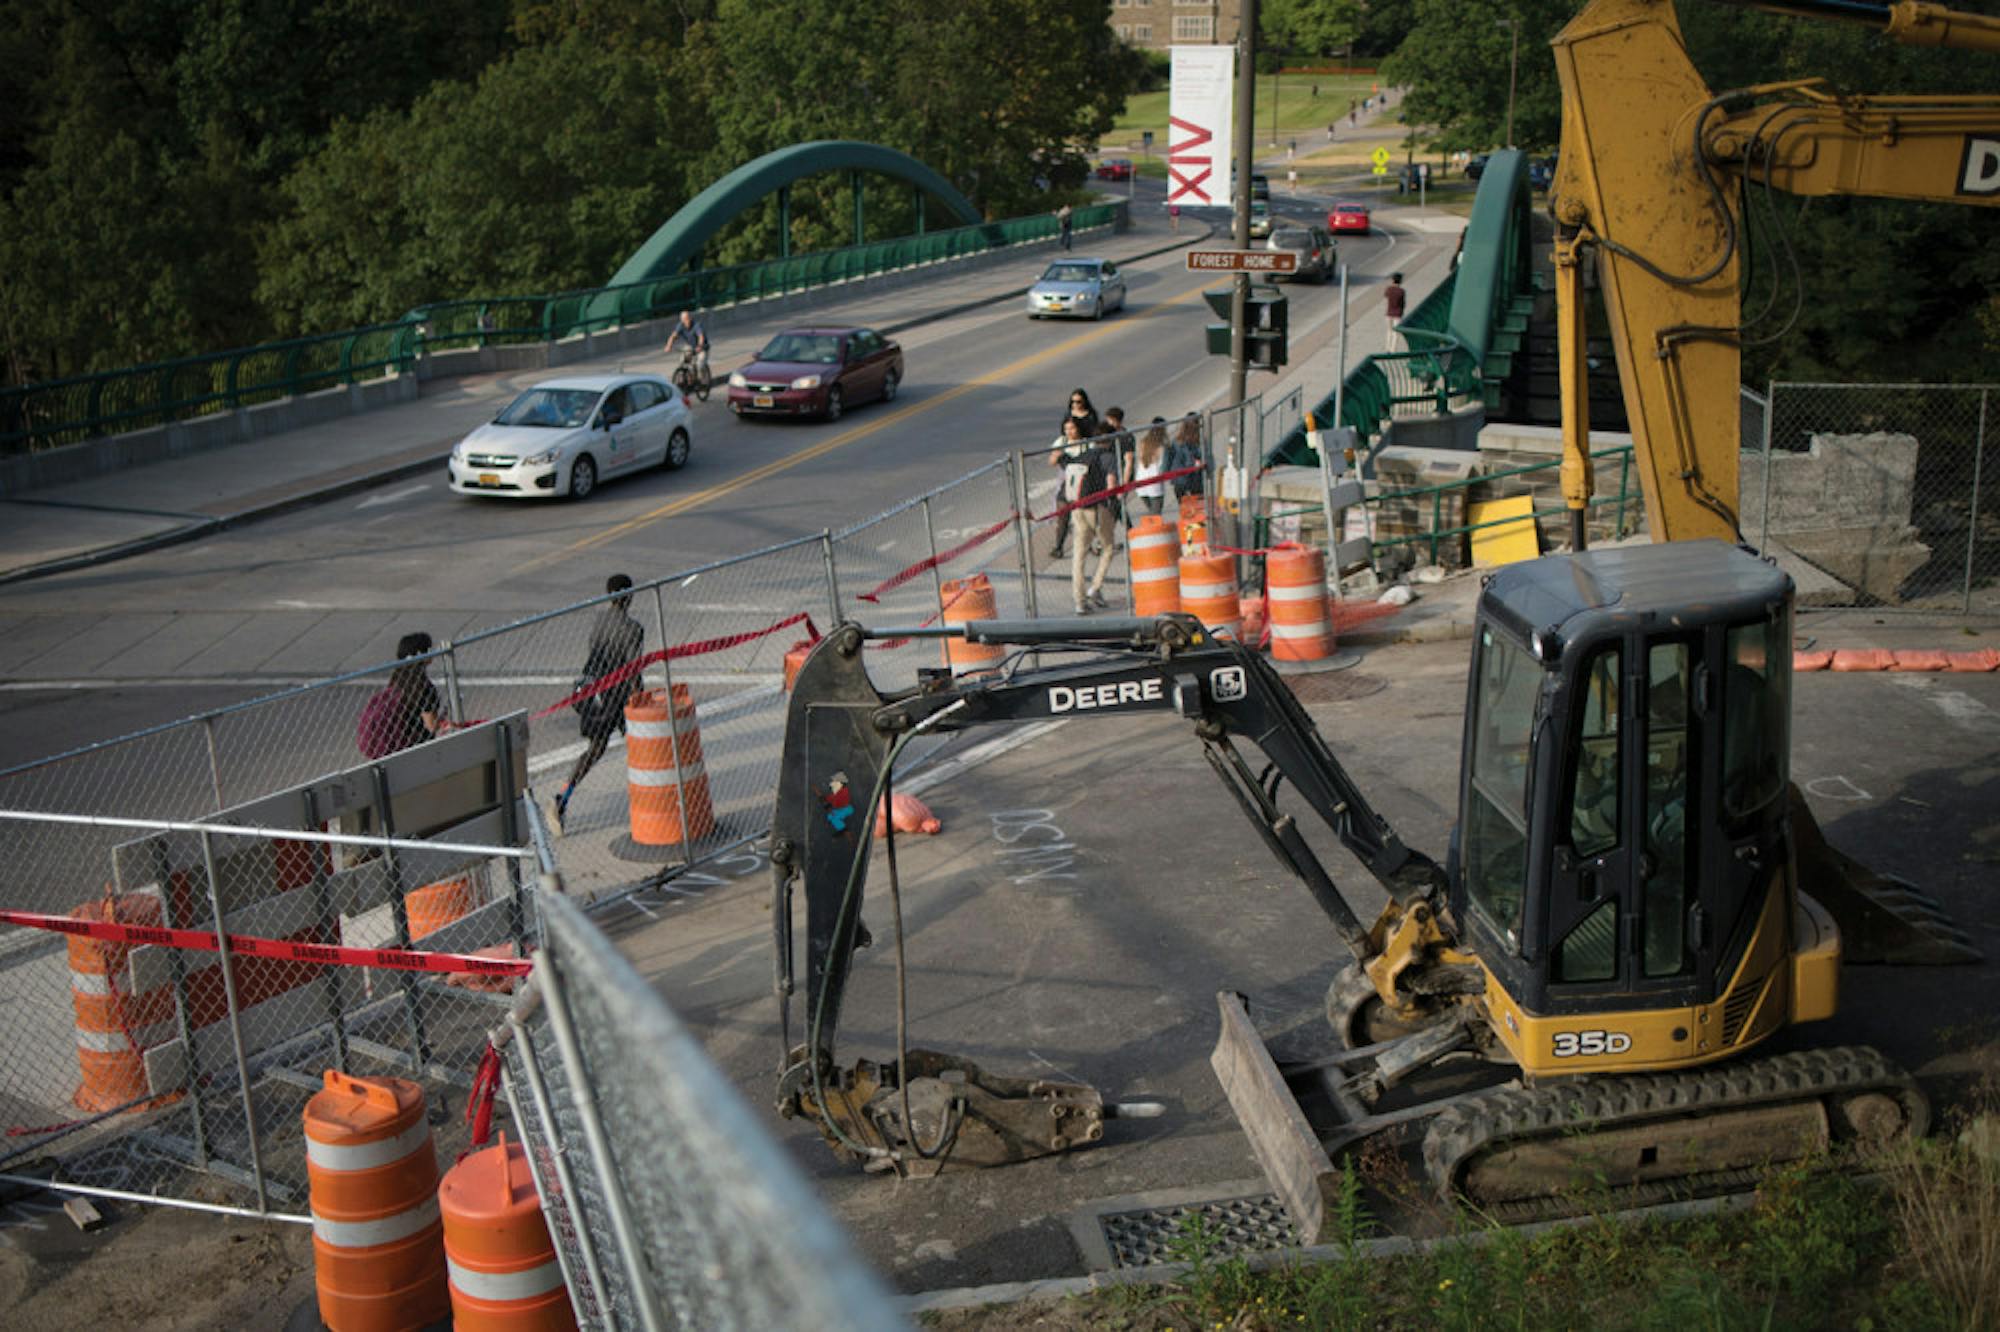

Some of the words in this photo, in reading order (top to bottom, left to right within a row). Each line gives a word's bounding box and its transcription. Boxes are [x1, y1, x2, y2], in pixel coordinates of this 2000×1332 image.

[1168, 116, 1212, 205] XIV
[1192, 253, 1236, 268] FOREST
[1243, 254, 1276, 269] HOME
[1049, 677, 1163, 713] DEERE
[125, 928, 174, 944] DANGER
[291, 946, 341, 961] DANGER
[377, 953, 427, 968] DANGER
[1553, 1030, 1632, 1057] 35D
